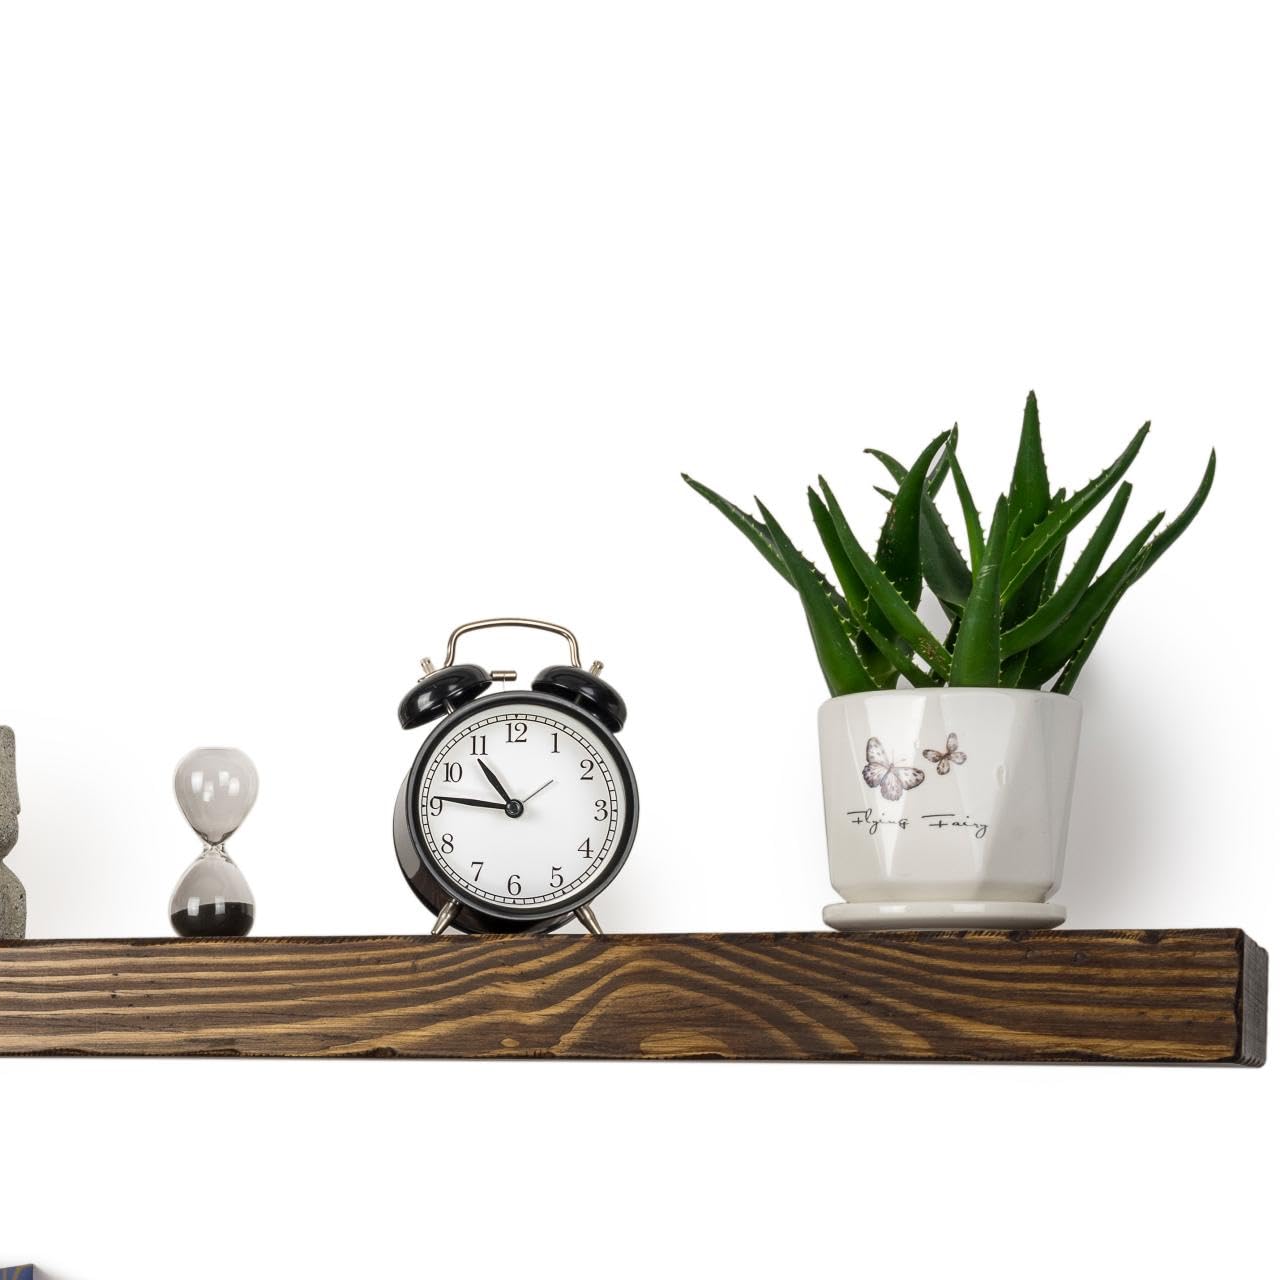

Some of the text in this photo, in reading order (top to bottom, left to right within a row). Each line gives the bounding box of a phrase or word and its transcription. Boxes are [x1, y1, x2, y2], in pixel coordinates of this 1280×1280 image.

[505, 722, 528, 743] 12
[550, 733, 561, 753] 1
[469, 735, 488, 755] 11
[442, 762, 463, 783] 10
[580, 759, 594, 780] 2
[430, 797, 443, 816] 9
[593, 800, 608, 821] 3
[846, 808, 910, 835] Flying
[921, 813, 989, 839] Fairy
[441, 833, 454, 854] 8
[577, 838, 594, 858] 4
[470, 861, 484, 882] 7
[549, 866, 564, 888] 5
[507, 874, 522, 895] 6
